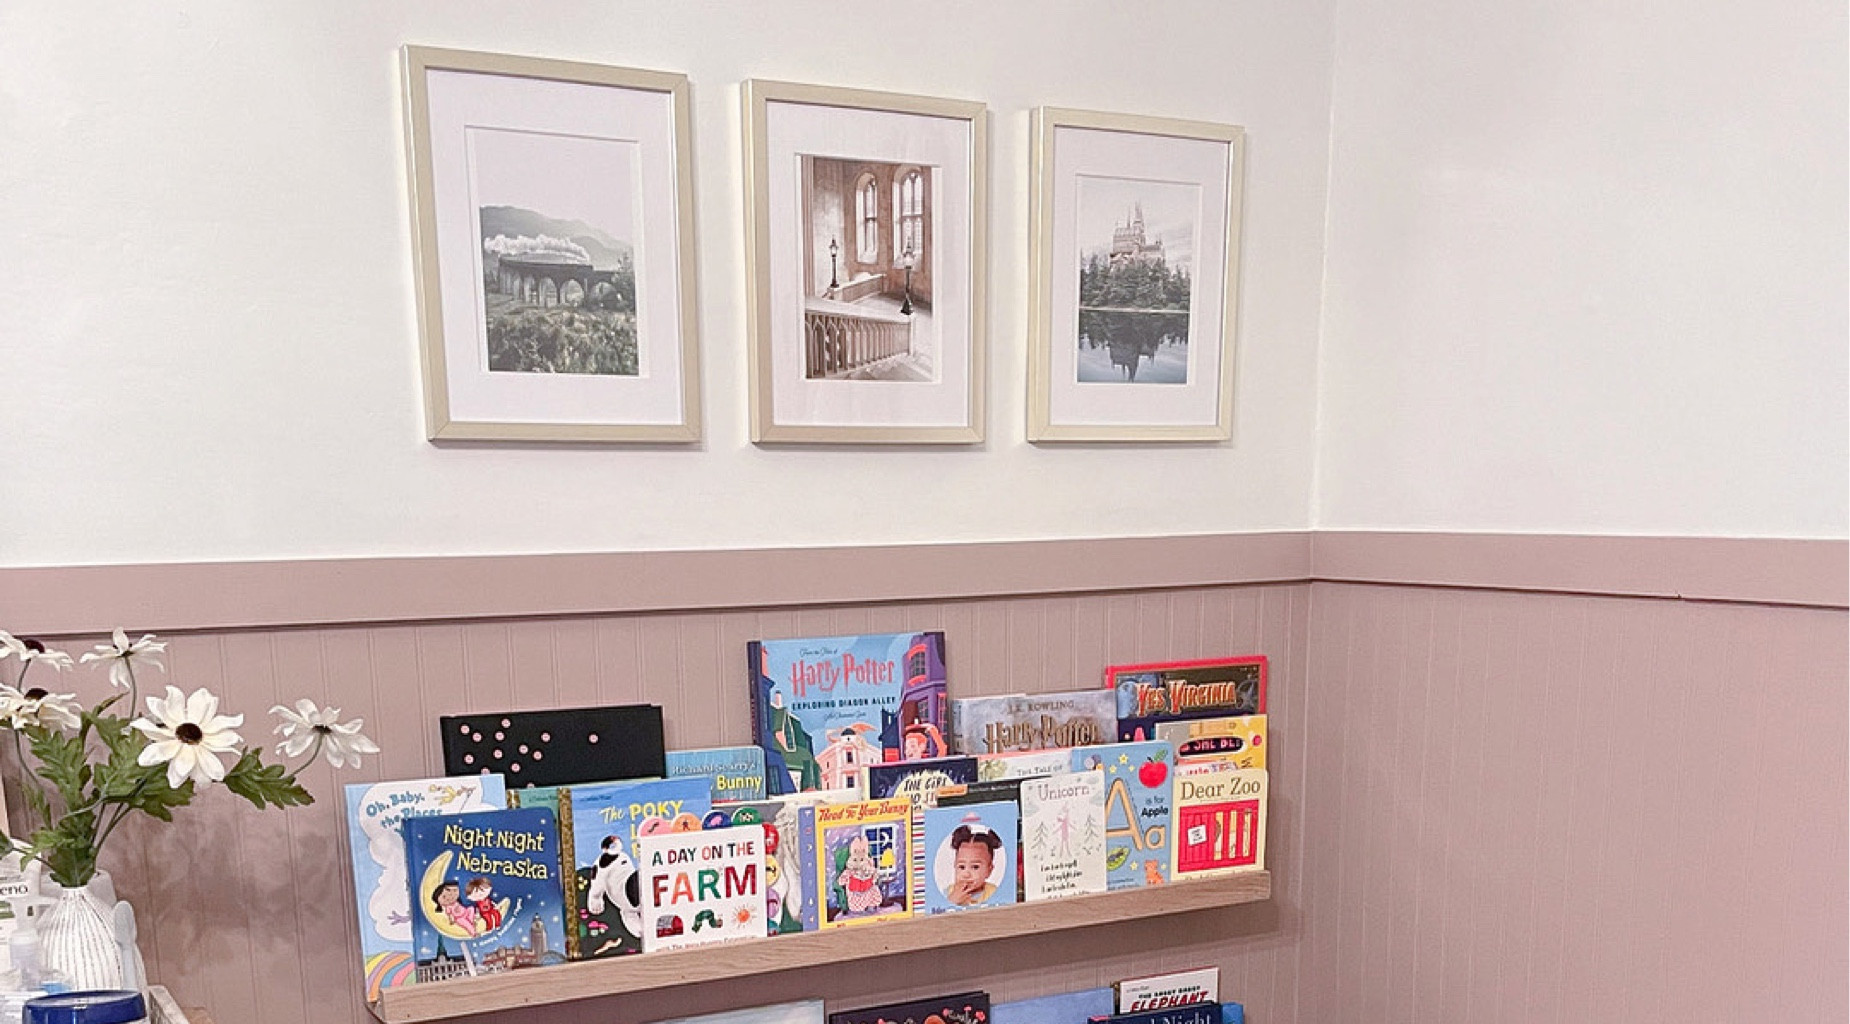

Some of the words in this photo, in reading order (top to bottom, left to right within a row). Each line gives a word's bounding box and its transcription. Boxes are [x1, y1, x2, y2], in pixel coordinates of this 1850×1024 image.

[789, 660, 840, 698] Harry
[842, 652, 895, 692] Potter
[871, 696, 895, 705] ALLEY
[1027, 700, 1075, 712] ROWLING
[982, 721, 1038, 754] Harry
[1040, 714, 1100, 749] Potter
[717, 774, 763, 792] Bunny
[1037, 782, 1090, 802] Unicorn
[1180, 780, 1225, 801] Dear
[1229, 776, 1261, 796] Zoo
[381, 815, 400, 829] the
[599, 806, 625, 825] The
[629, 799, 684, 820] POKY
[818, 806, 844, 823] Read
[857, 803, 879, 821] Your
[879, 801, 910, 816] Bunny
[1141, 805, 1169, 819] Apple
[652, 850, 664, 867] A
[667, 847, 698, 864] DAY
[701, 844, 724, 861] ON
[726, 841, 756, 857] THE
[456, 852, 549, 880] Nebraska
[652, 862, 758, 908] FARM
[1130, 991, 1210, 1012] ELEPHANT
